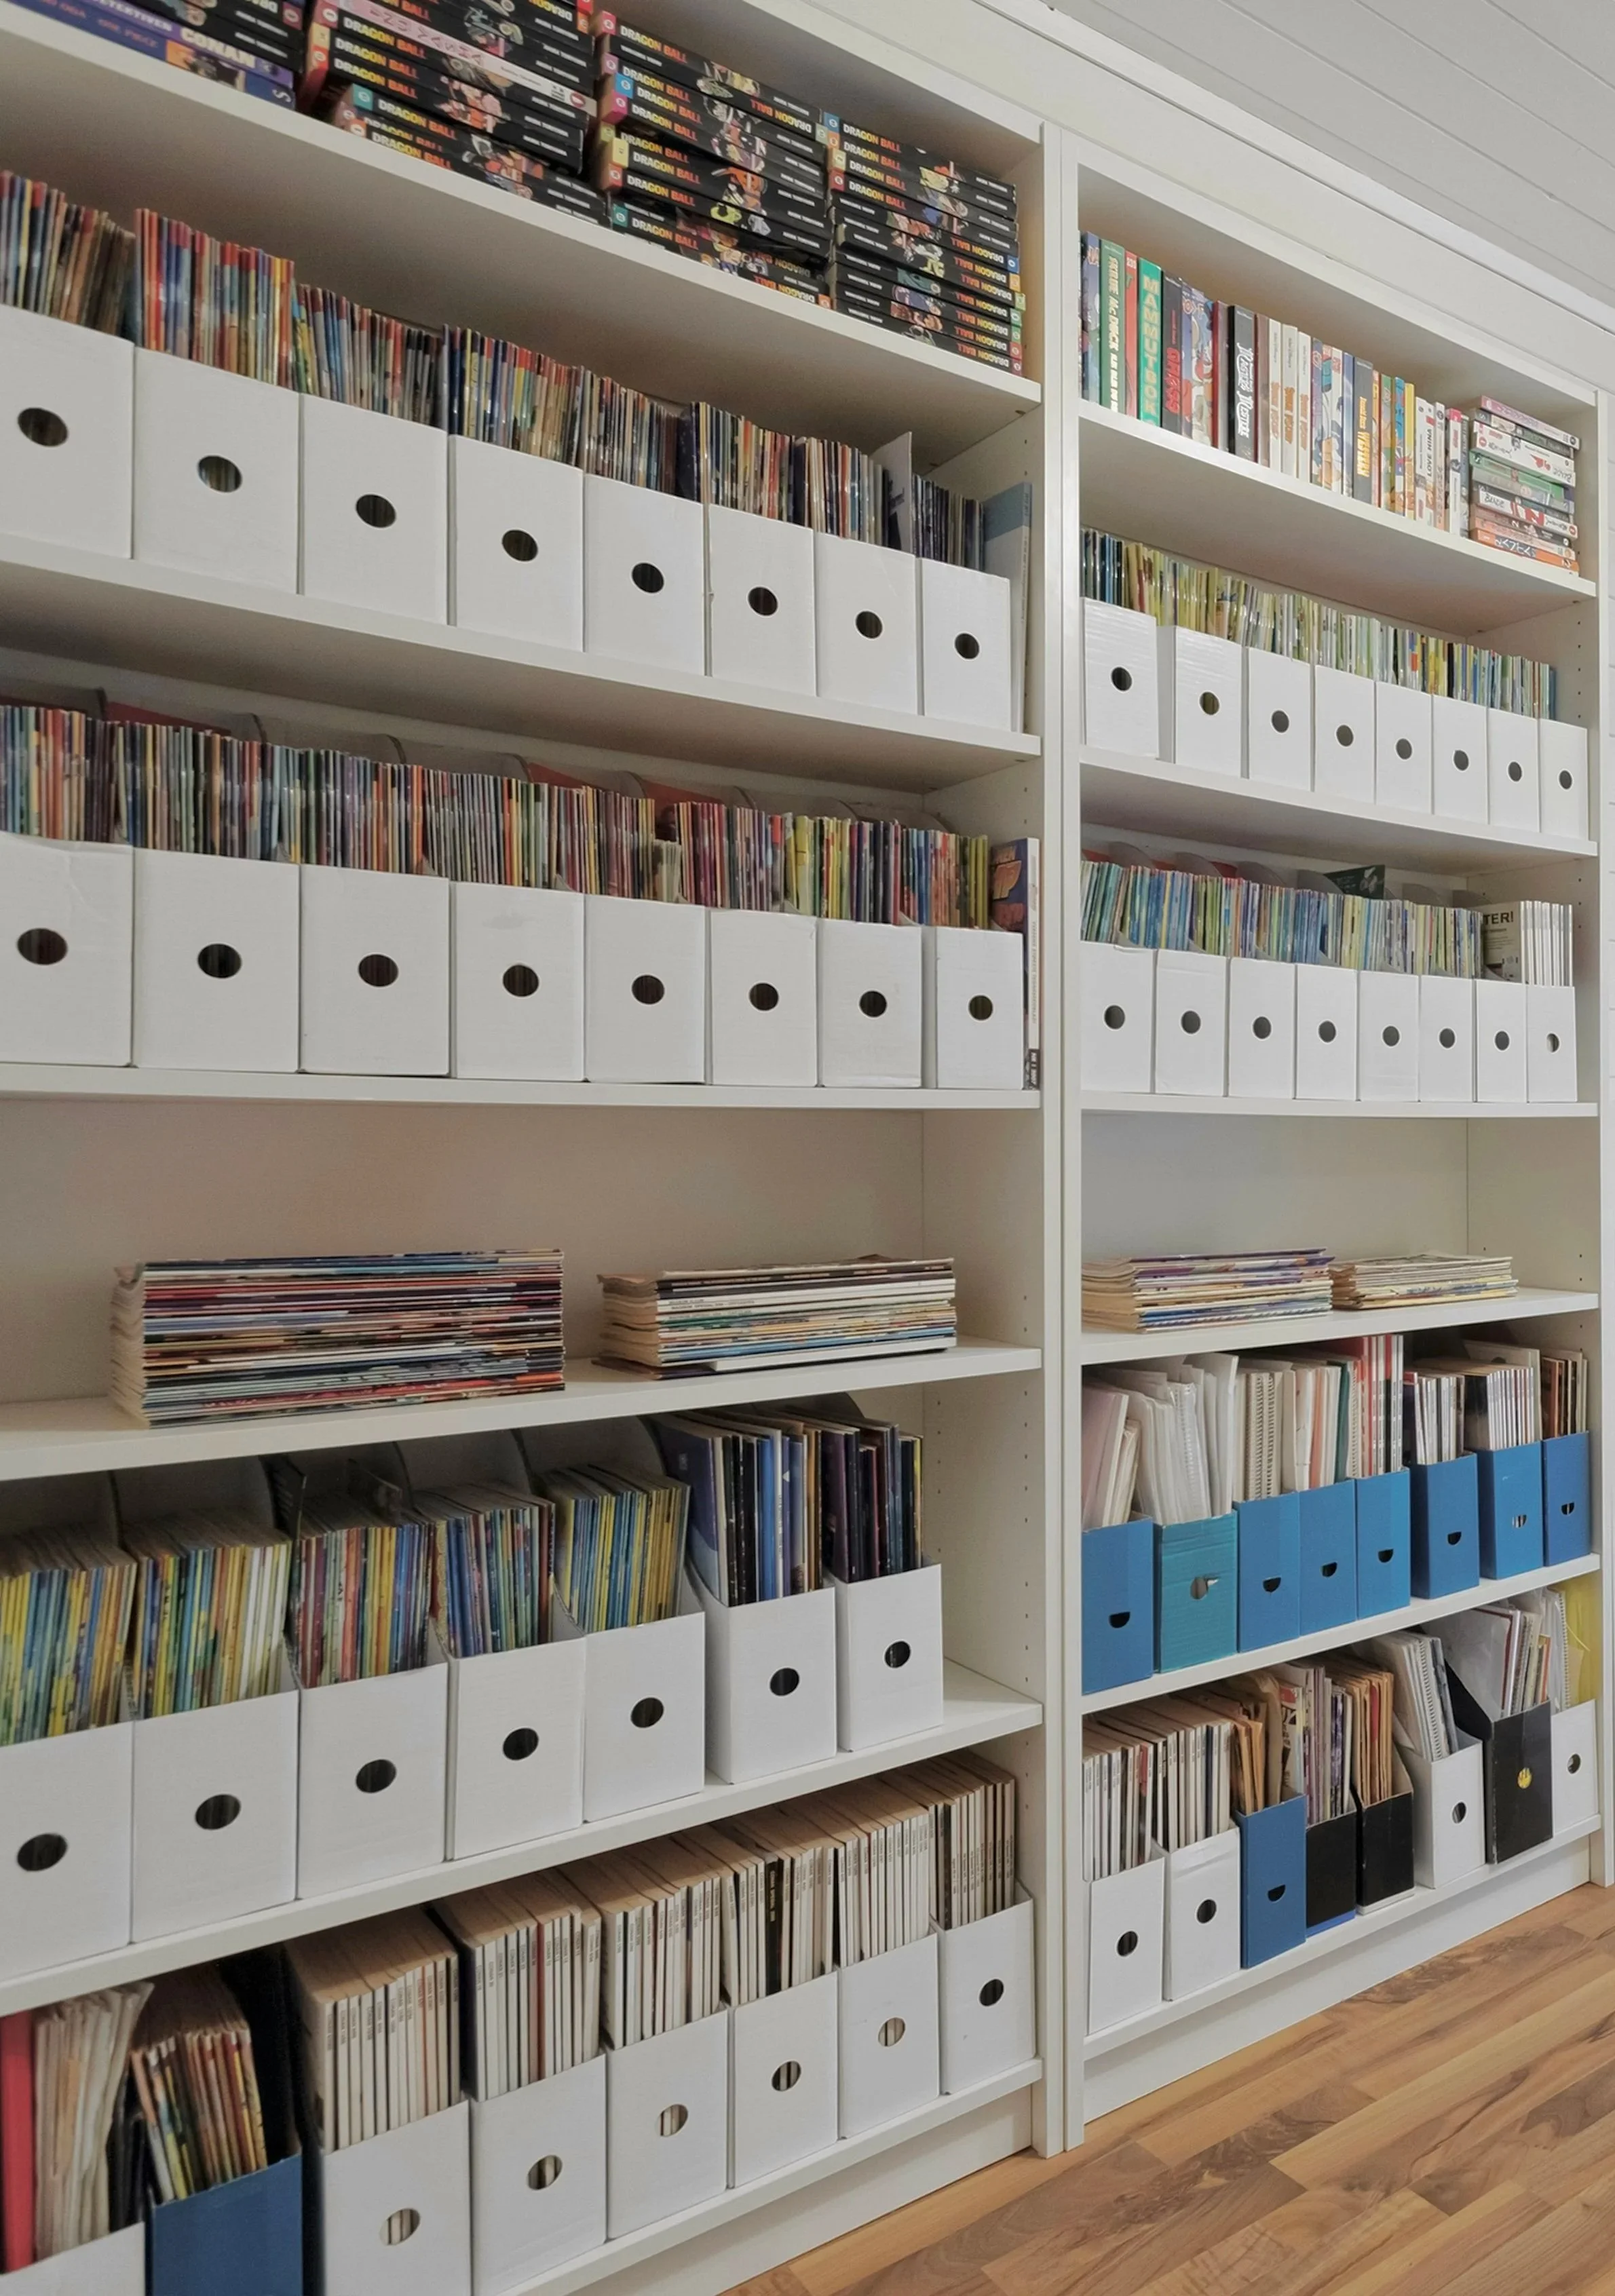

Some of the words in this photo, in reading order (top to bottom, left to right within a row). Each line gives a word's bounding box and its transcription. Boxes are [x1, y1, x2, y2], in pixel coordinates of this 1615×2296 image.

[180, 27, 256, 69] CONAN
[344, 16, 396, 46] DRAGON
[396, 38, 428, 60] BALL
[620, 24, 662, 52] DRAGON
[662, 40, 688, 64] BALL
[335, 37, 388, 66] DRAGON
[388, 58, 420, 80] BALL
[335, 58, 386, 92] DRAGON
[387, 79, 418, 100] BALL
[623, 66, 665, 92] DRAGON
[666, 83, 691, 103] BALL
[378, 98, 427, 126] DRAGON
[429, 117, 457, 140] BALL
[632, 104, 673, 130] DRAGON
[674, 122, 698, 142] BALL
[636, 86, 677, 113] DRAGON
[679, 107, 703, 125] BALL
[372, 132, 422, 160] DRAGON
[843, 123, 879, 146] DRAGON
[880, 138, 902, 153] BALL
[843, 140, 879, 162] DRAGON
[880, 155, 902, 171] BALL
[632, 152, 675, 175] DRAGON
[677, 169, 701, 185] BALL
[849, 160, 884, 182] DRAGON
[885, 175, 907, 191] BALL
[627, 174, 668, 197] DRAGON
[670, 189, 696, 207] BALL
[849, 180, 884, 202] DRAGON
[885, 195, 907, 210] BALL
[632, 217, 672, 241] DRAGON
[674, 231, 699, 250] BALL
